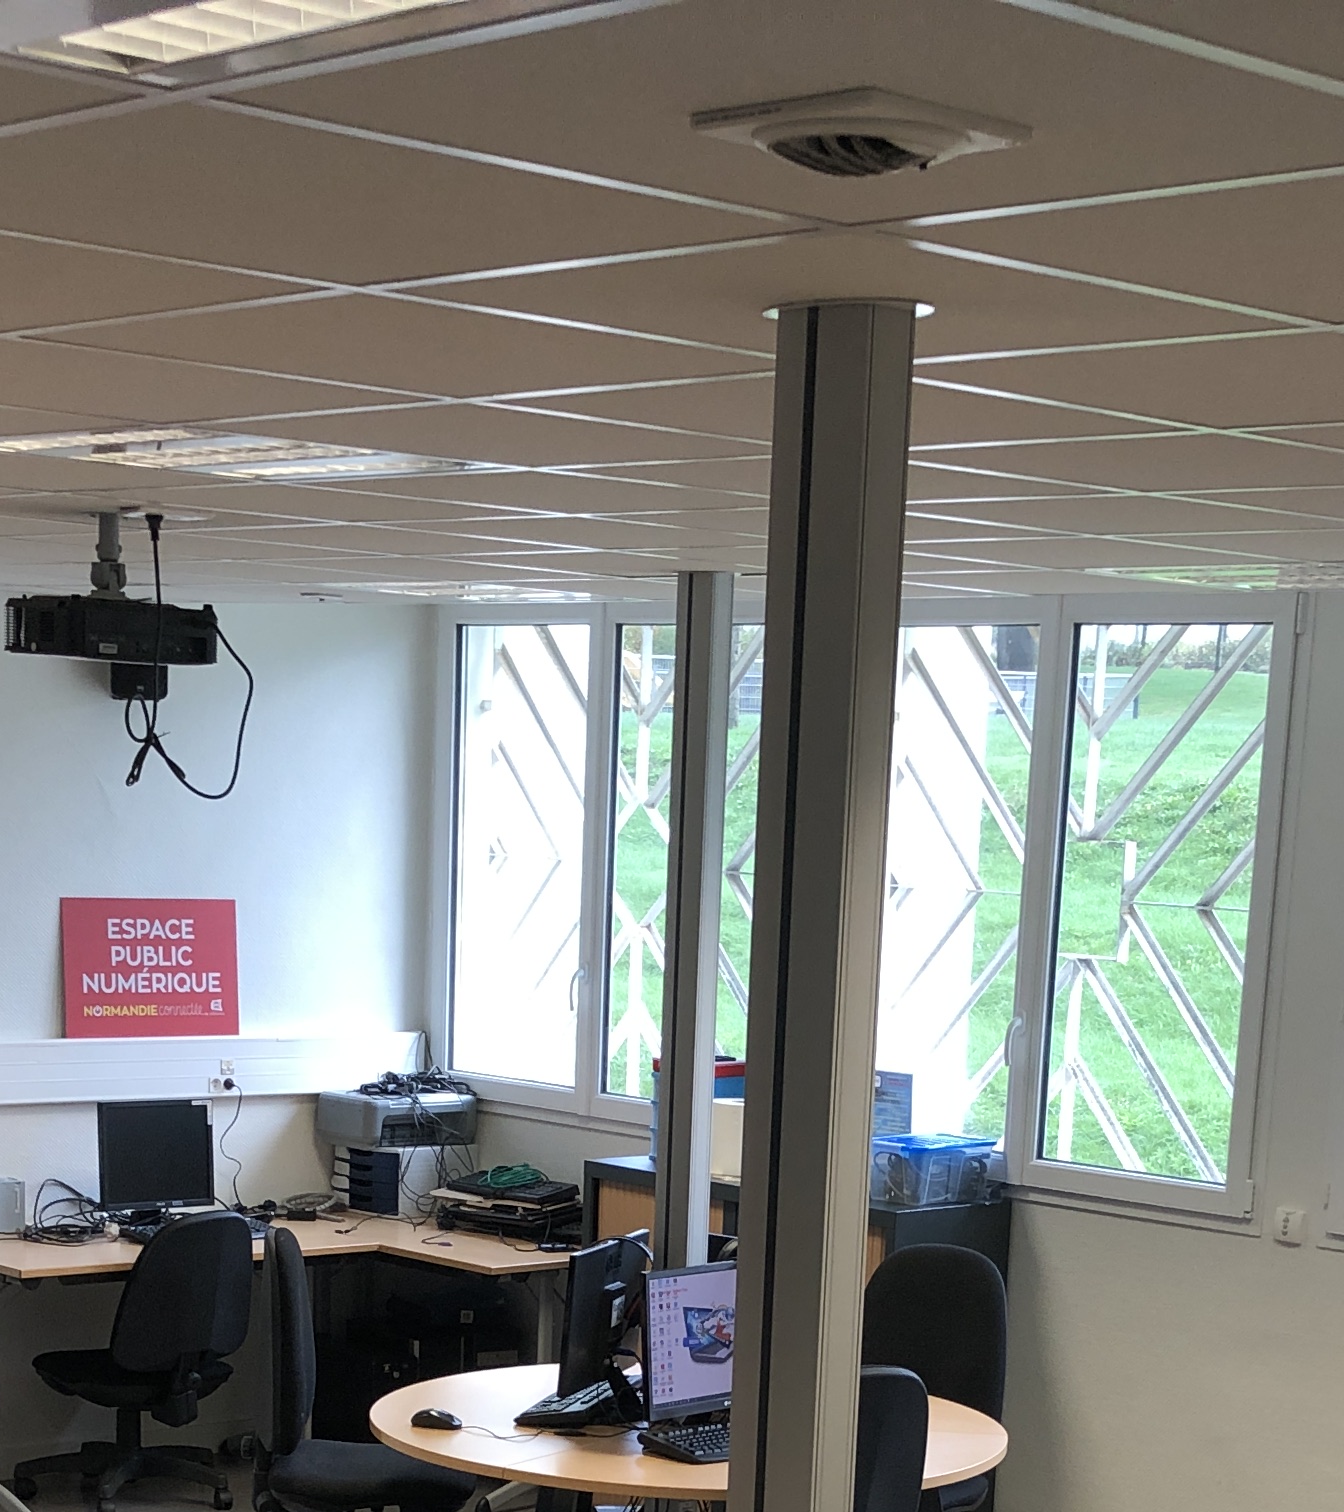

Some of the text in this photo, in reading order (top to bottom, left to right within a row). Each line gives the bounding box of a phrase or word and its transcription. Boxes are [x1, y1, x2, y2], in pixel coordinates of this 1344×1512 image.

[107, 918, 195, 940] ESPACE
[111, 945, 193, 967] PUBLIC
[82, 967, 222, 994] NUMÉRIQUE
[83, 1004, 158, 1017] NORMANDIE
